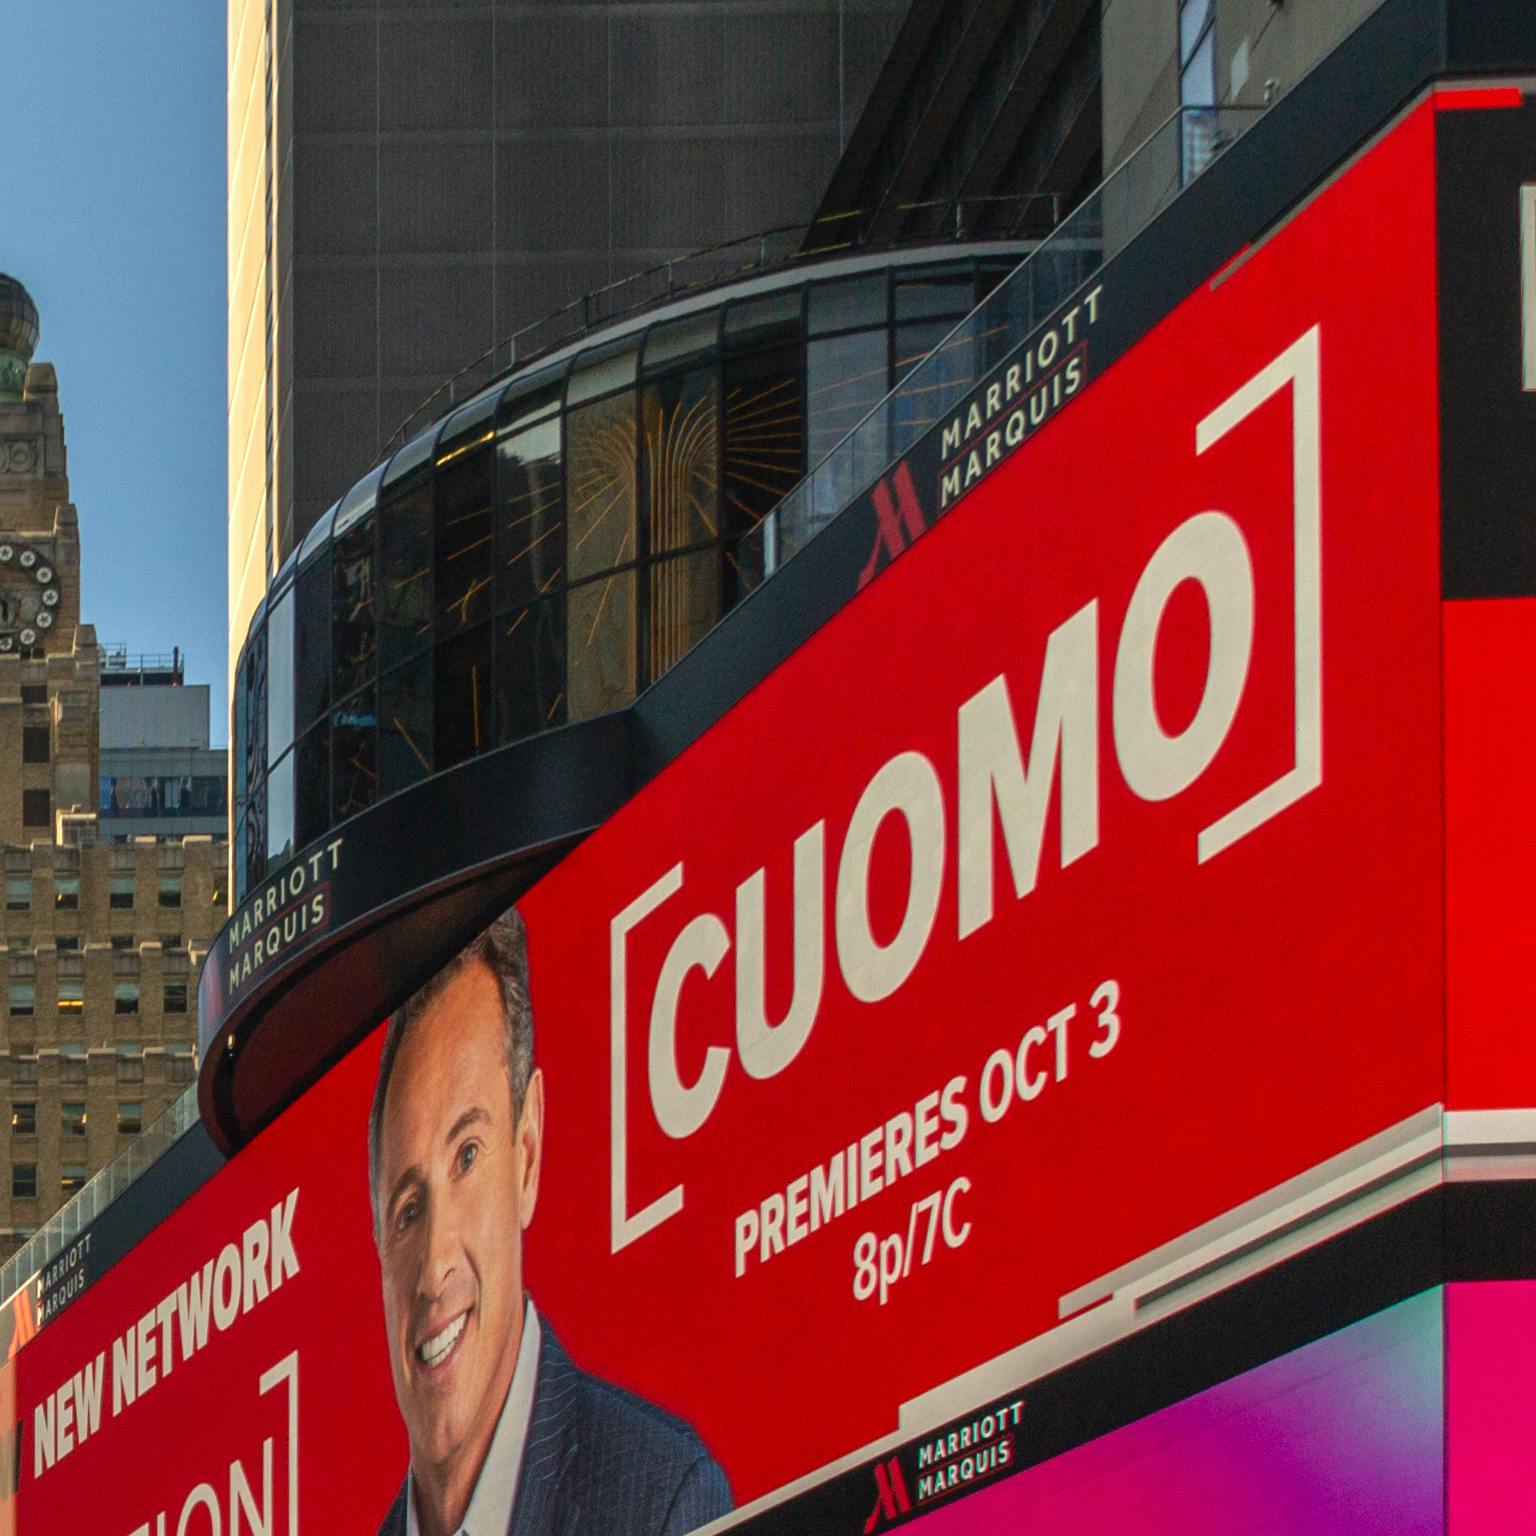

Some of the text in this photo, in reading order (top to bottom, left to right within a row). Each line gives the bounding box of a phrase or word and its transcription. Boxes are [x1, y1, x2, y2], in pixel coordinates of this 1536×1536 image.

[941, 284, 1103, 460] MARRIOTT
[941, 357, 1081, 508] MARQUIS
[648, 510, 1255, 1140] CUOMO
[229, 838, 344, 954] MARRIOTT
[229, 893, 325, 995] MARQUIS
[733, 977, 1122, 1278] PREMIERES OCT 3
[36, 1233, 92, 1298] MARRIOTT
[36, 1268, 86, 1326] MARQUIS
[852, 1176, 973, 1307] 8p/7C
[34, 1186, 301, 1480] NEW NETWORK
[917, 1400, 1025, 1469] MARRIOTT
[917, 1440, 1011, 1500] MARQUIS
